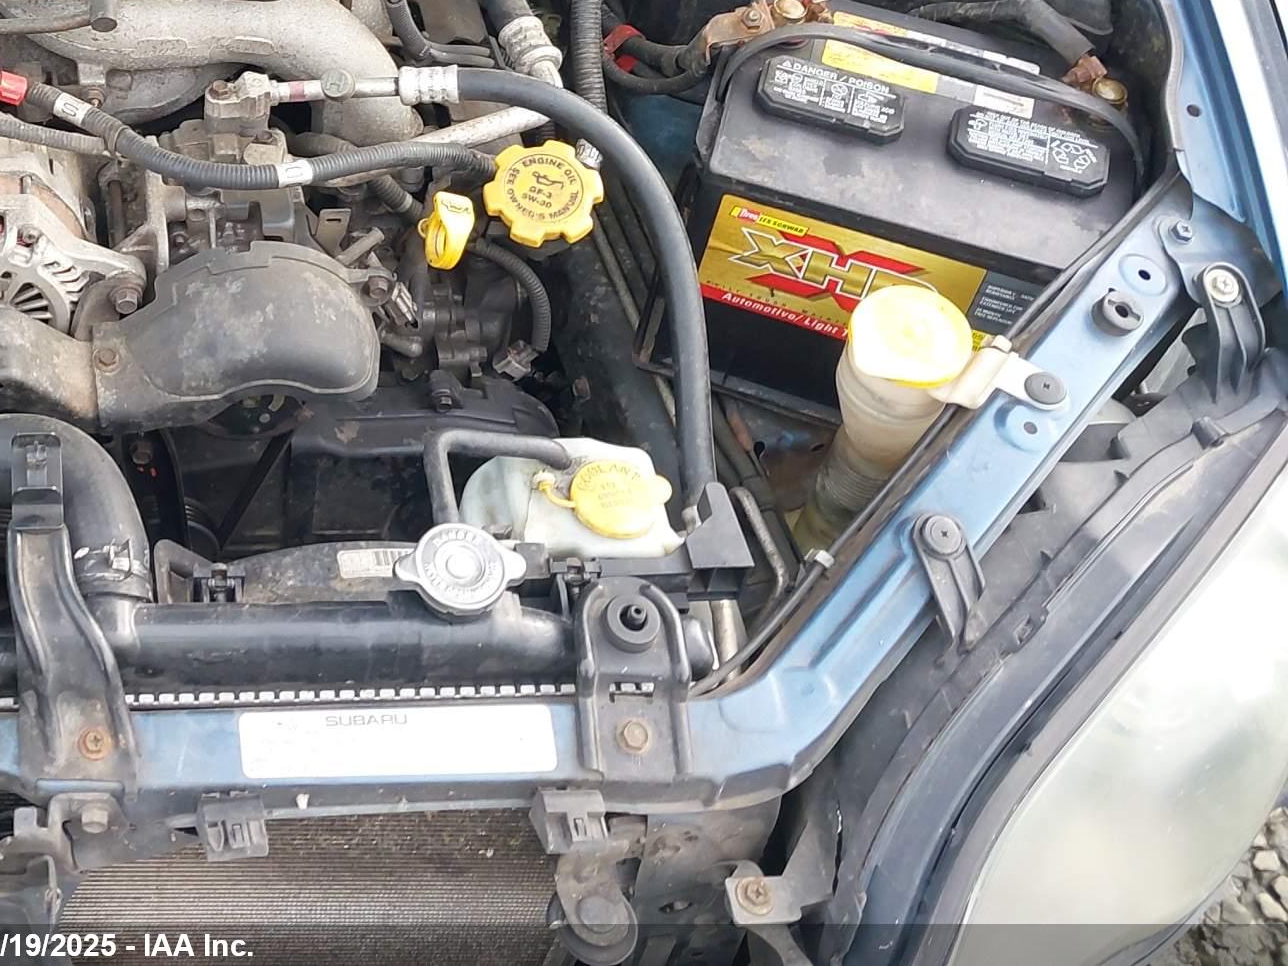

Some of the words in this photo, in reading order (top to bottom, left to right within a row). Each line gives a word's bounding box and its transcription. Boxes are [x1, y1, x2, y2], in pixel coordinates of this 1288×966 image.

[793, 60, 838, 81] DANGER
[849, 76, 890, 94] POISON
[522, 157, 565, 170] ENGINE
[564, 169, 577, 184] OIL
[506, 167, 521, 186] SEE
[549, 189, 579, 219] MANUAL
[804, 317, 839, 335] Light
[325, 714, 408, 728] SUBARU
